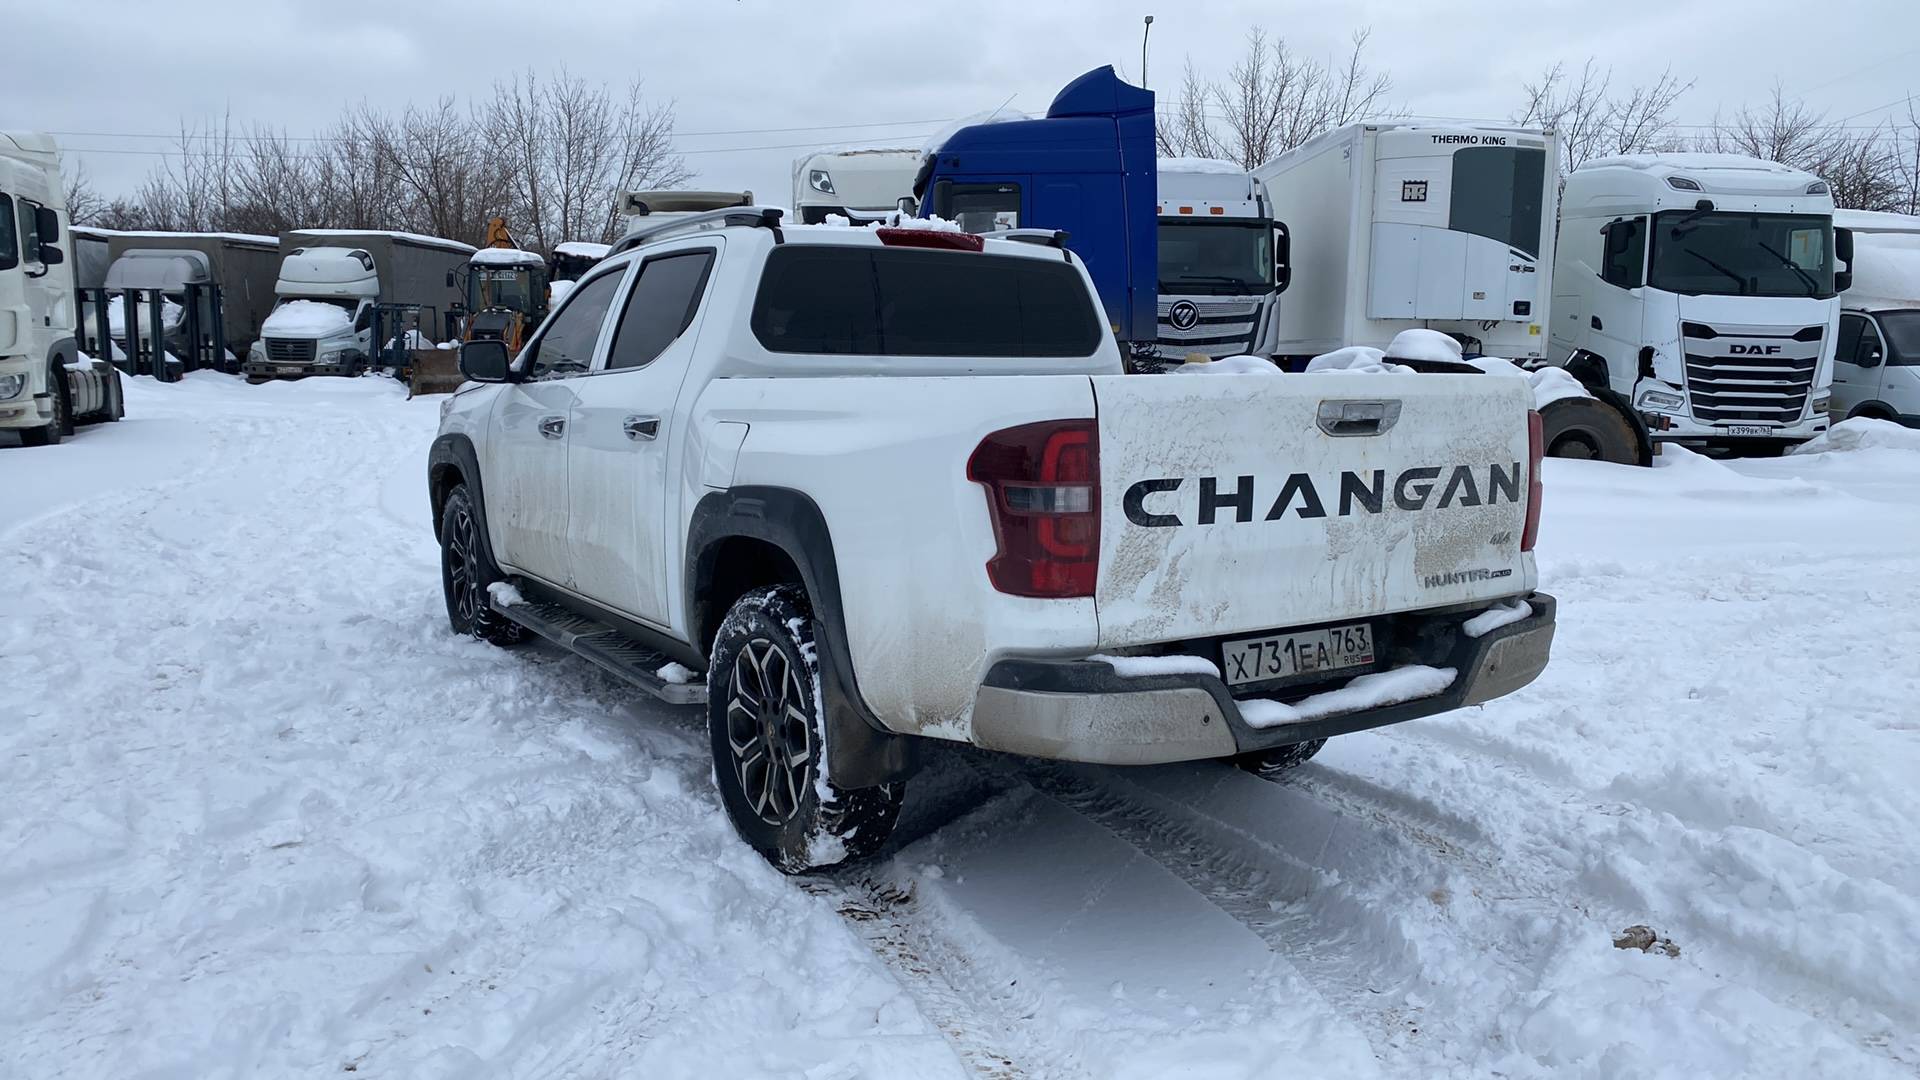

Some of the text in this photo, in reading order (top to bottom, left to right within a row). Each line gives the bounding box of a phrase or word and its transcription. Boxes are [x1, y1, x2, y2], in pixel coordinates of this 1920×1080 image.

[1431, 134, 1506, 146] THERMO KING
[1729, 344, 1781, 355] DAF
[1122, 461, 1521, 528] CHANGAN
[1424, 568, 1490, 589] HUNTER
[1331, 627, 1367, 656] 763
[1343, 655, 1361, 665] RUS
